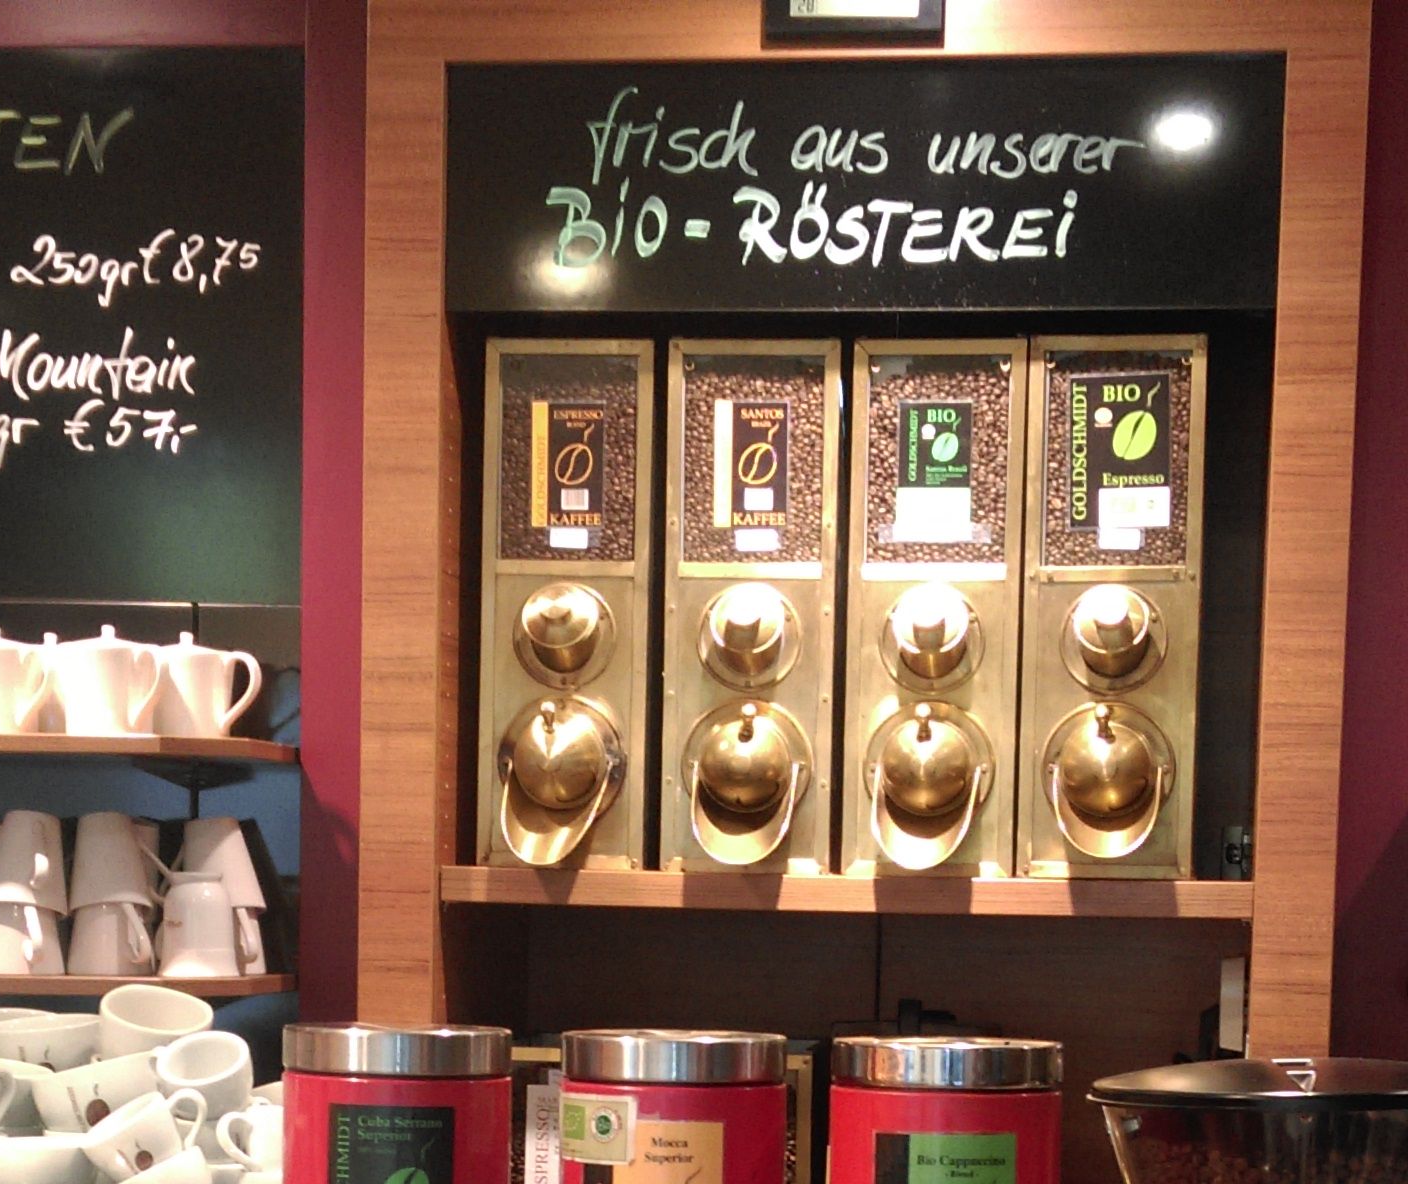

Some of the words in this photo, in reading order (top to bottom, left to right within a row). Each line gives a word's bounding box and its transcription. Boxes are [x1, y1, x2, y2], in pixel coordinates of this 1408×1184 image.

[587, 86, 757, 185] frisch
[791, 125, 888, 174] aus
[927, 123, 1146, 179] unserer
[732, 182, 1078, 268] RÖSTEREI
[1102, 384, 1141, 402] BIO
[741, 408, 785, 420] SANTOS
[927, 409, 956, 423] BIO
[908, 409, 919, 482] GOLDSCHMIDT
[1073, 383, 1087, 520] GOLDSCHMIDT
[1102, 473, 1164, 488] Espresso
[550, 513, 602, 526] KAFFEE
[733, 513, 786, 526] KAFFEE
[358, 1115, 391, 1128] Cuba
[395, 1115, 443, 1128] Serrano
[358, 1130, 412, 1143] Superior
[651, 1137, 689, 1149] Mocca
[644, 1153, 695, 1165] Superior
[916, 1155, 936, 1166] Bio
[940, 1155, 1006, 1168] Cappuccino
